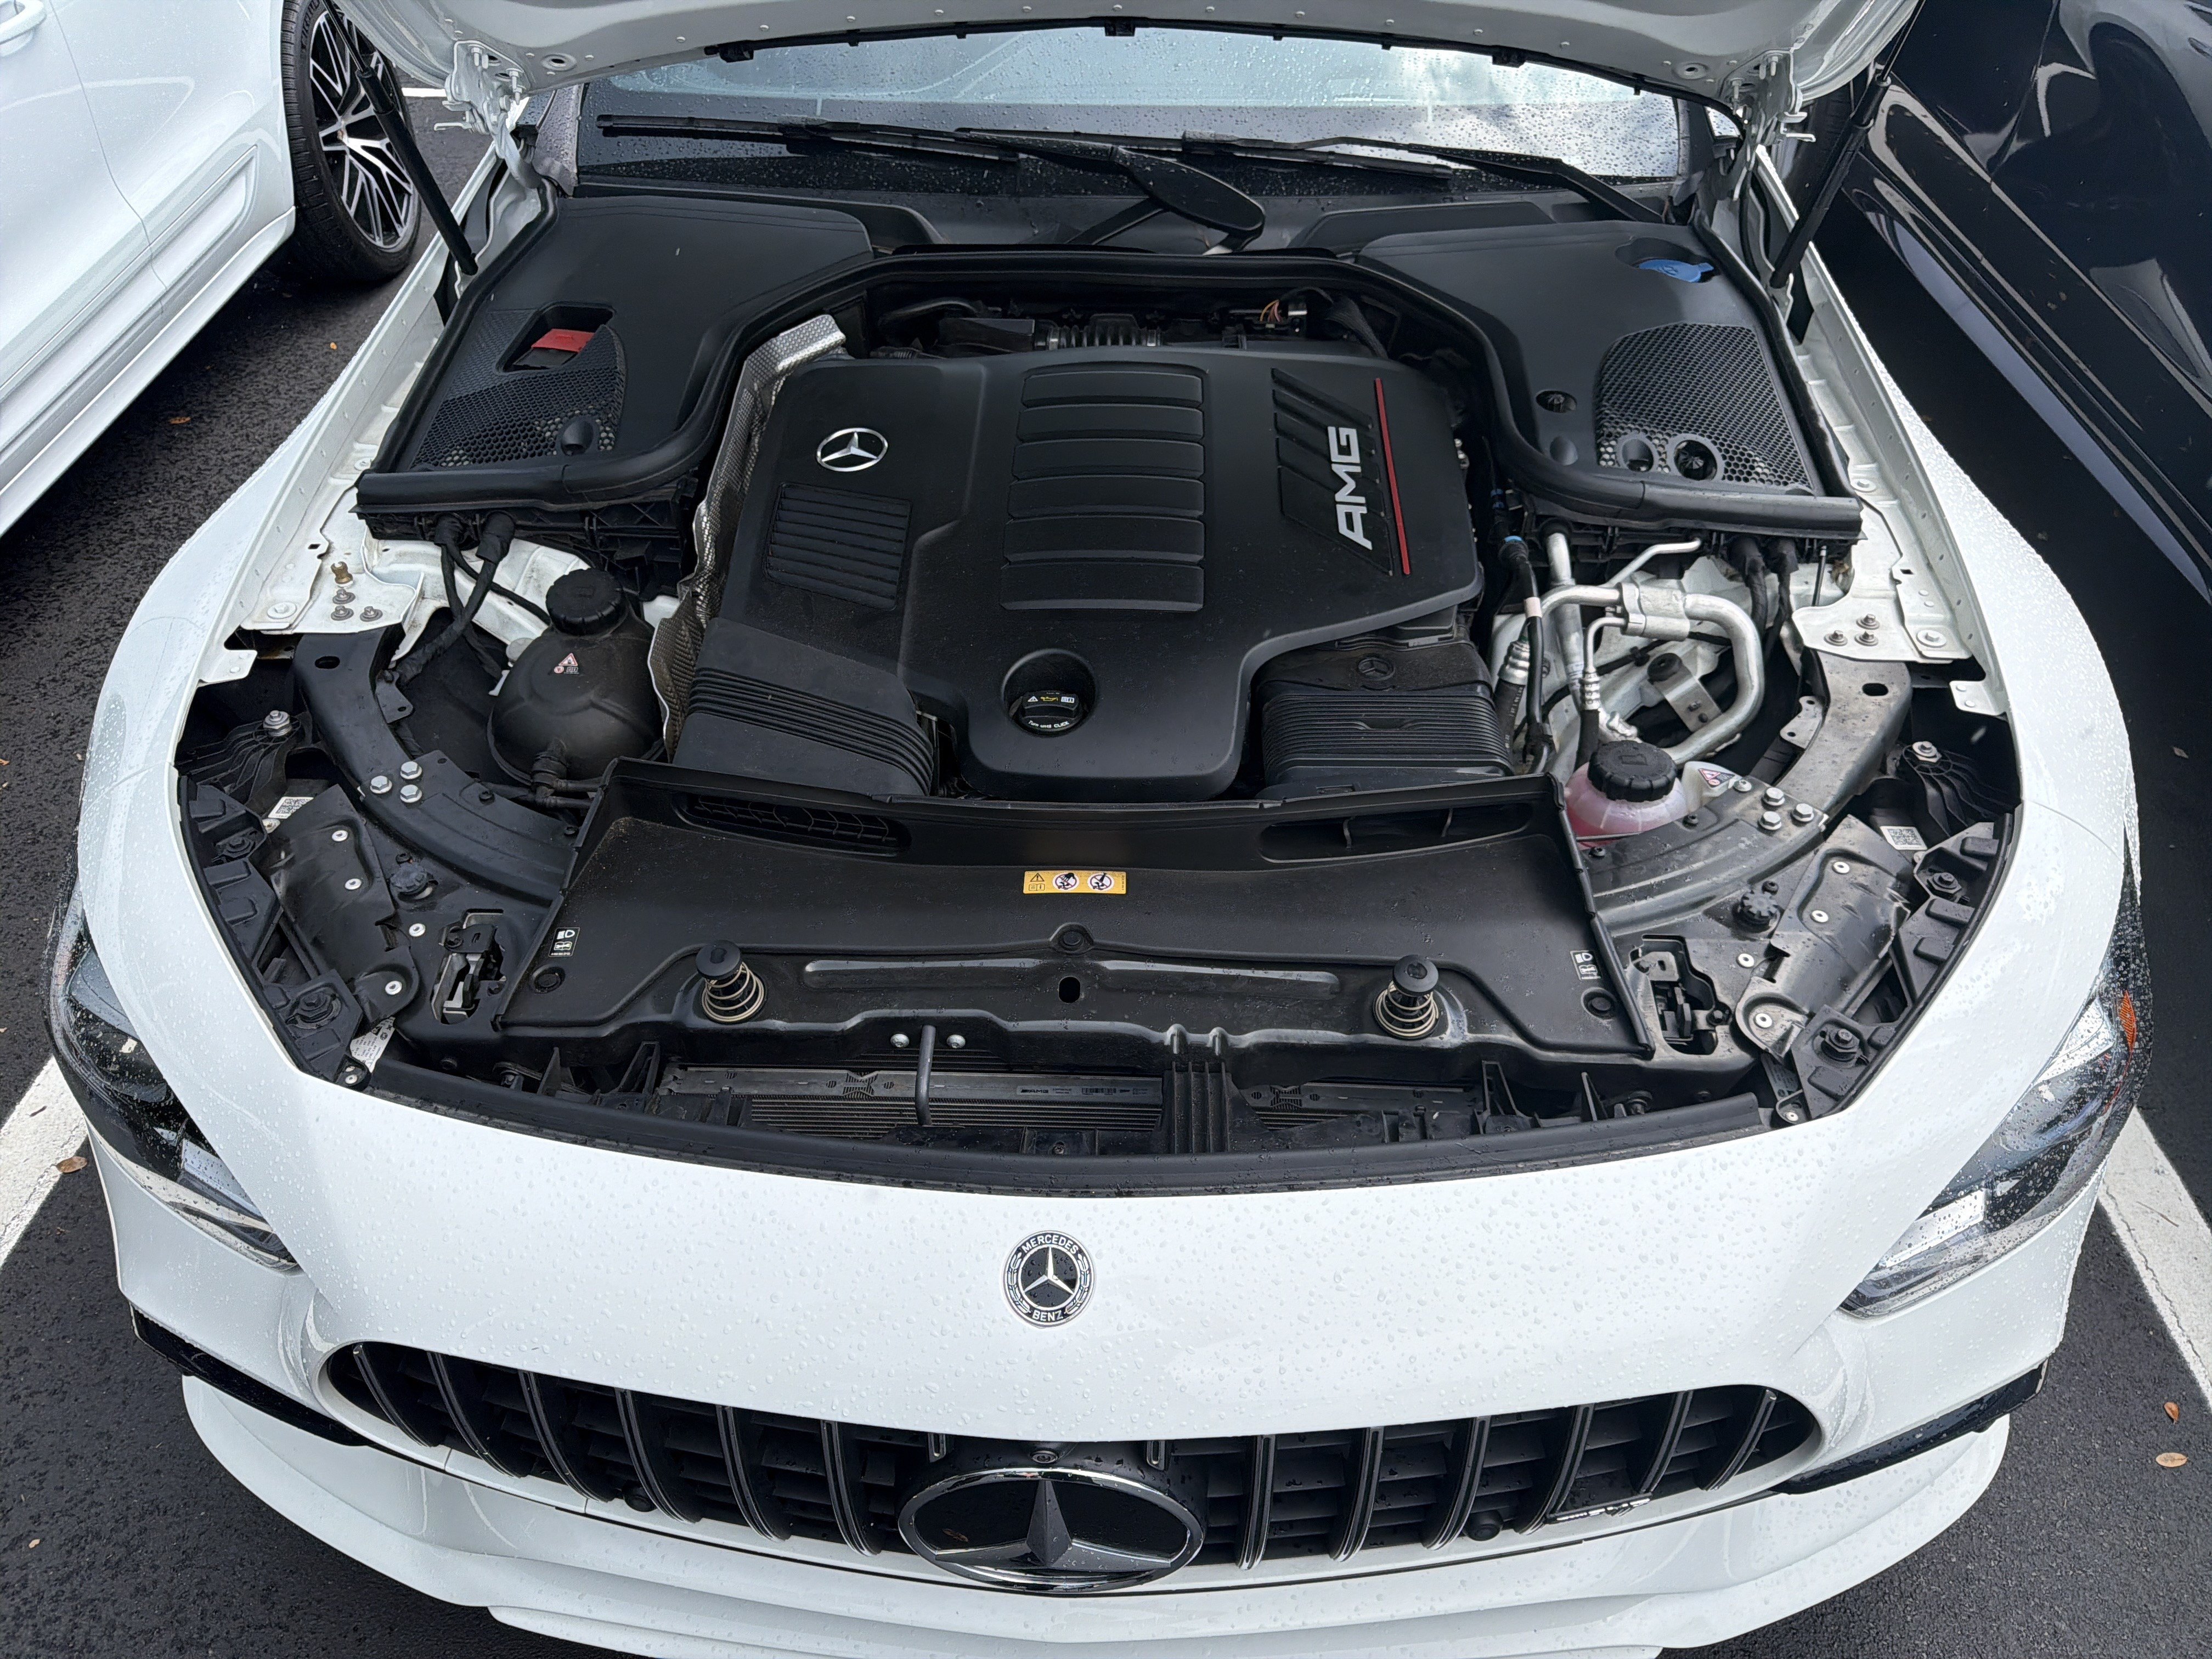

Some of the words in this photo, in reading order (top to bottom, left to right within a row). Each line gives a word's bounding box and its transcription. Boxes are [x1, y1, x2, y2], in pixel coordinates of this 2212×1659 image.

[1328, 426, 1372, 550] AMG
[1021, 1234, 1079, 1254] MERCEDES
[1032, 1310, 1064, 1322] BENZ
